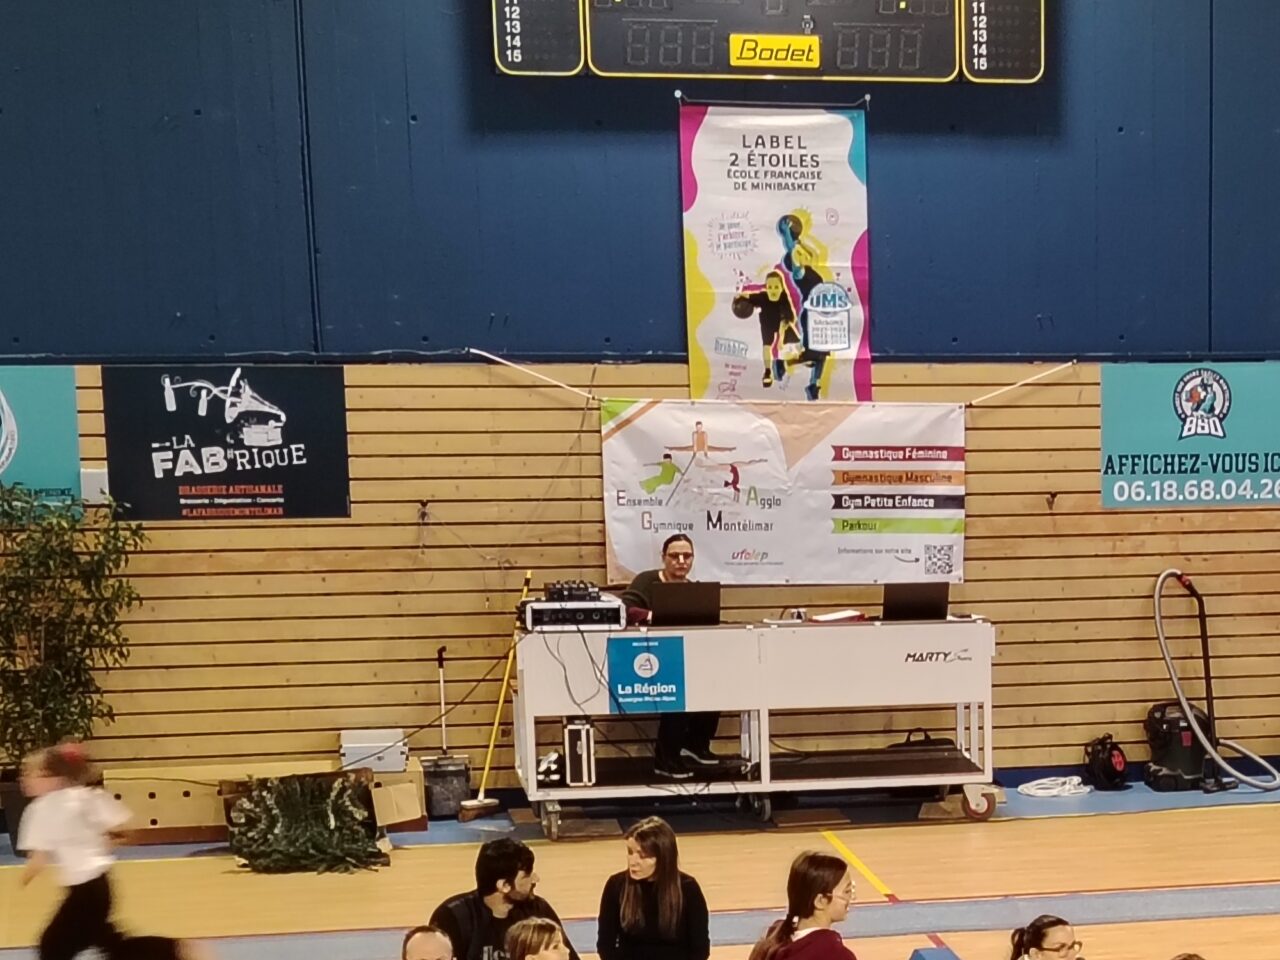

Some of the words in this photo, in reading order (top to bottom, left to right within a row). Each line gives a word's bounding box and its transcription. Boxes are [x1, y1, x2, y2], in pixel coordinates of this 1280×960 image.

[504, 7, 520, 19] 12
[504, 21, 521, 33] 13
[972, 16, 987, 28] 12
[505, 35, 521, 47] 14
[972, 30, 987, 42] 13
[506, 50, 522, 62] 15
[736, 38, 814, 62] Bodet
[972, 44, 987, 56] 14
[972, 57, 987, 70] 15
[742, 134, 807, 149] LABEL
[729, 153, 739, 167] 2
[747, 150, 820, 168] ÉTOILES
[727, 169, 760, 179] ÉCOLE
[763, 170, 823, 181] FRANÇAISE
[733, 182, 747, 191] DE
[751, 182, 816, 192] MINIBASKET
[810, 293, 848, 309] UMS
[172, 434, 195, 449] LA
[842, 447, 904, 461] Gymnastique
[905, 447, 948, 459] Féminine
[1103, 453, 1259, 475] AFFICHEZ-VOUS
[842, 471, 903, 485] Gymnastique
[905, 472, 952, 483] Masculine
[616, 489, 663, 507] Ensemble
[746, 486, 782, 509] Agglo
[841, 496, 862, 510] Gym
[864, 496, 893, 507] Petite
[895, 496, 935, 508] Enfance
[641, 511, 694, 533] Gymnique
[706, 510, 774, 532] Montélimar
[842, 520, 878, 531] Parkour
[731, 548, 769, 562] ufolep
[904, 651, 952, 662] MARTY
[617, 684, 632, 694] La
[633, 682, 677, 696] Région
